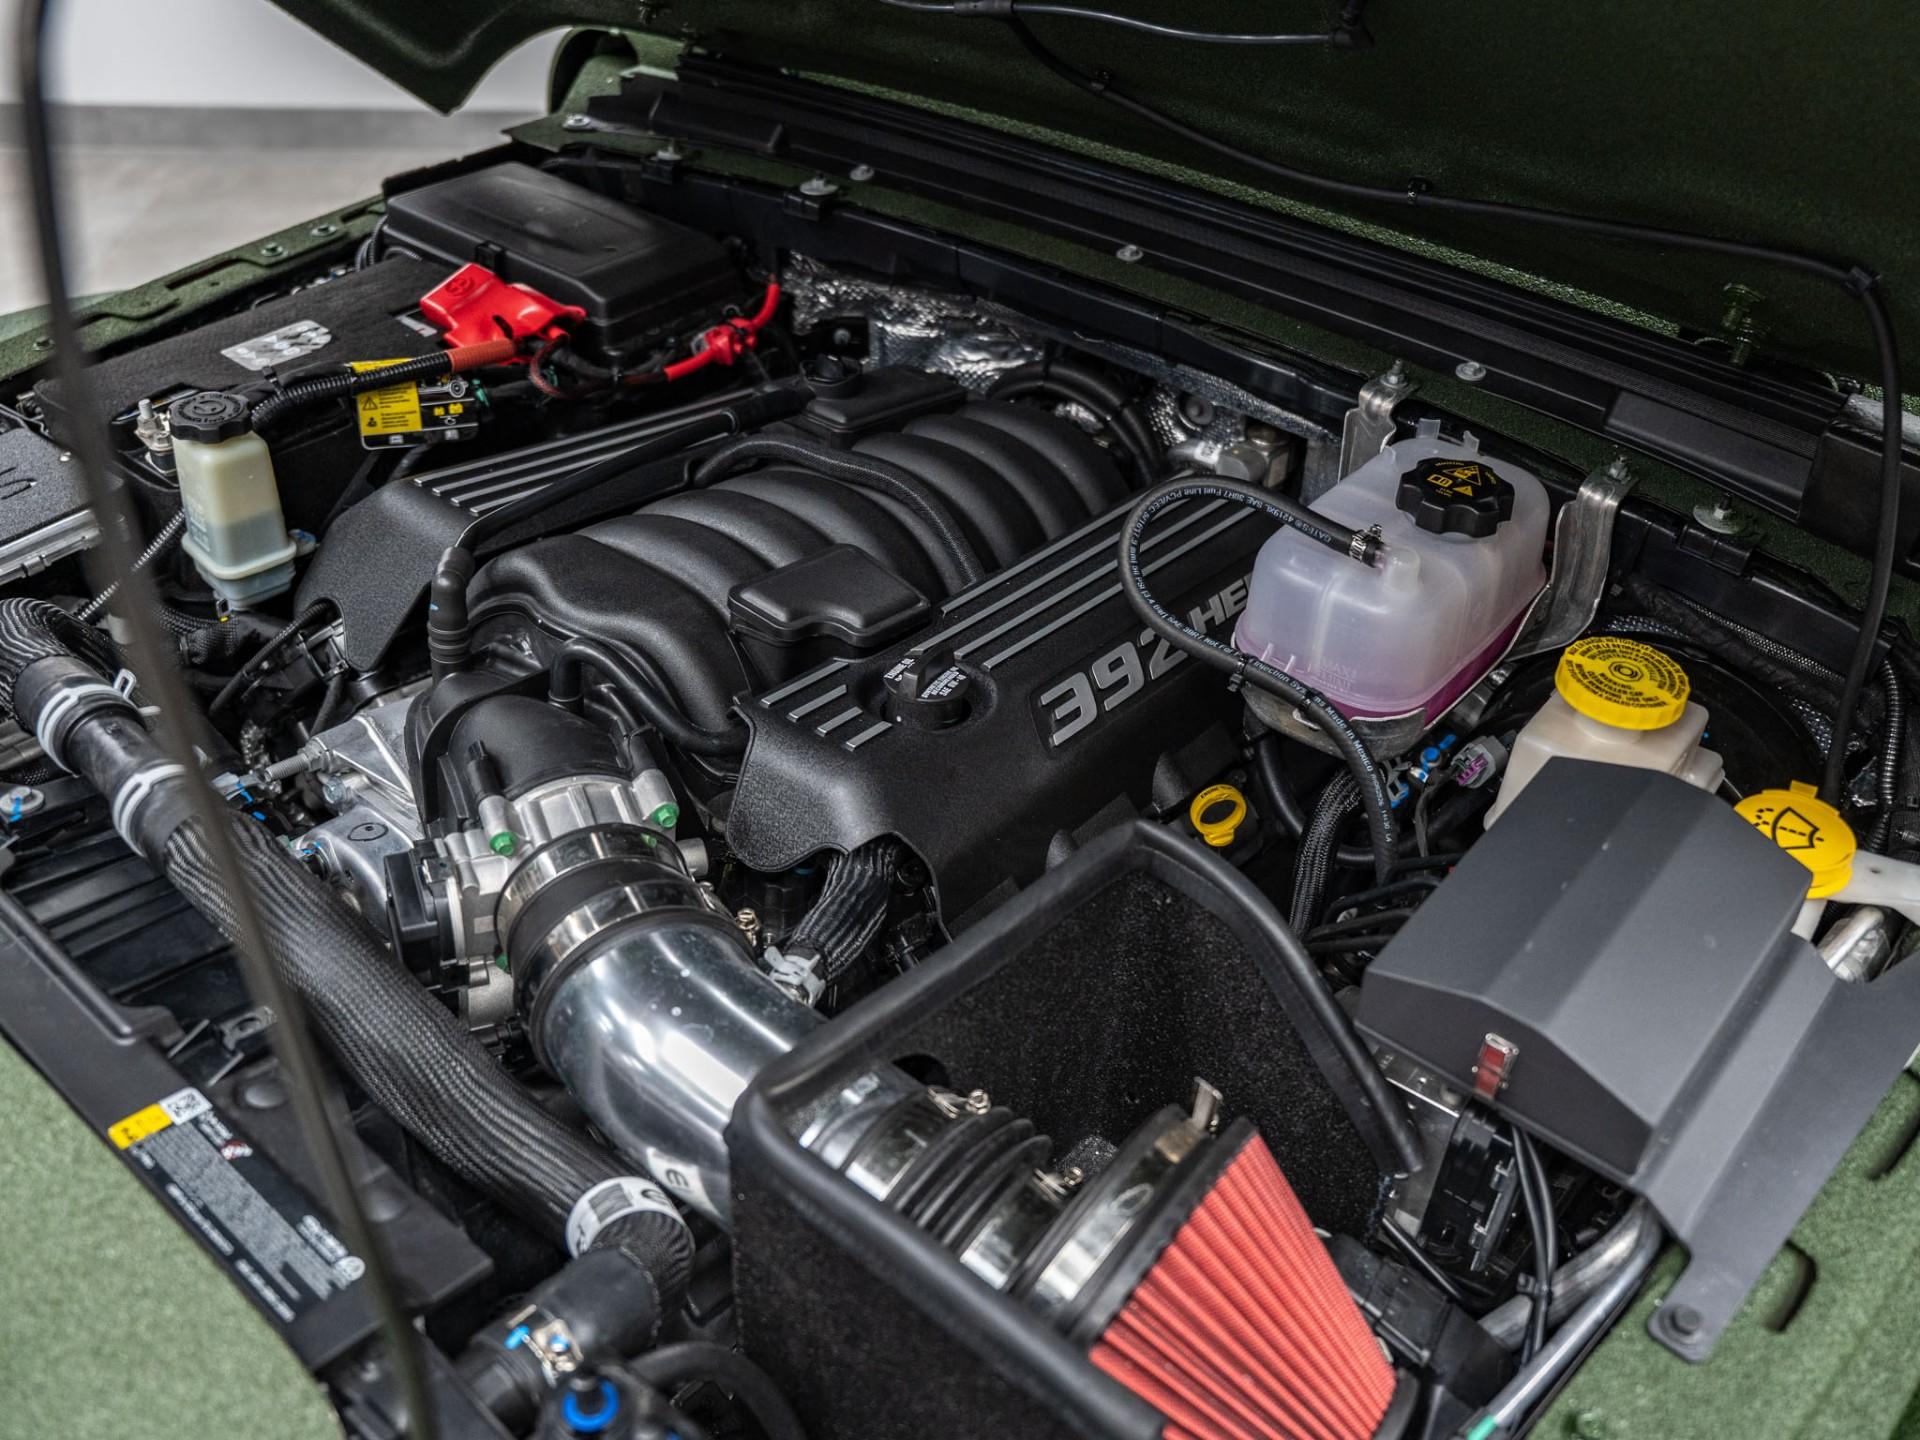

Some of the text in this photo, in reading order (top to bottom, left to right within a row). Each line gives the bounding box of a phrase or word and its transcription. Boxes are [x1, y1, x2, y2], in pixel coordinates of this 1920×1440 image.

[1184, 487, 1201, 496] Line
[1203, 487, 1222, 496] Fuel
[1247, 496, 1263, 508] SAE
[1203, 637, 1220, 648] Not
[1218, 644, 1234, 654] For
[1254, 660, 1291, 683] Injection
[1039, 627, 1189, 746] 392
[1289, 680, 1326, 708] Sysms
[1325, 705, 1348, 729] Made
[1345, 729, 1355, 740] in
[1352, 739, 1374, 773] Mexico
